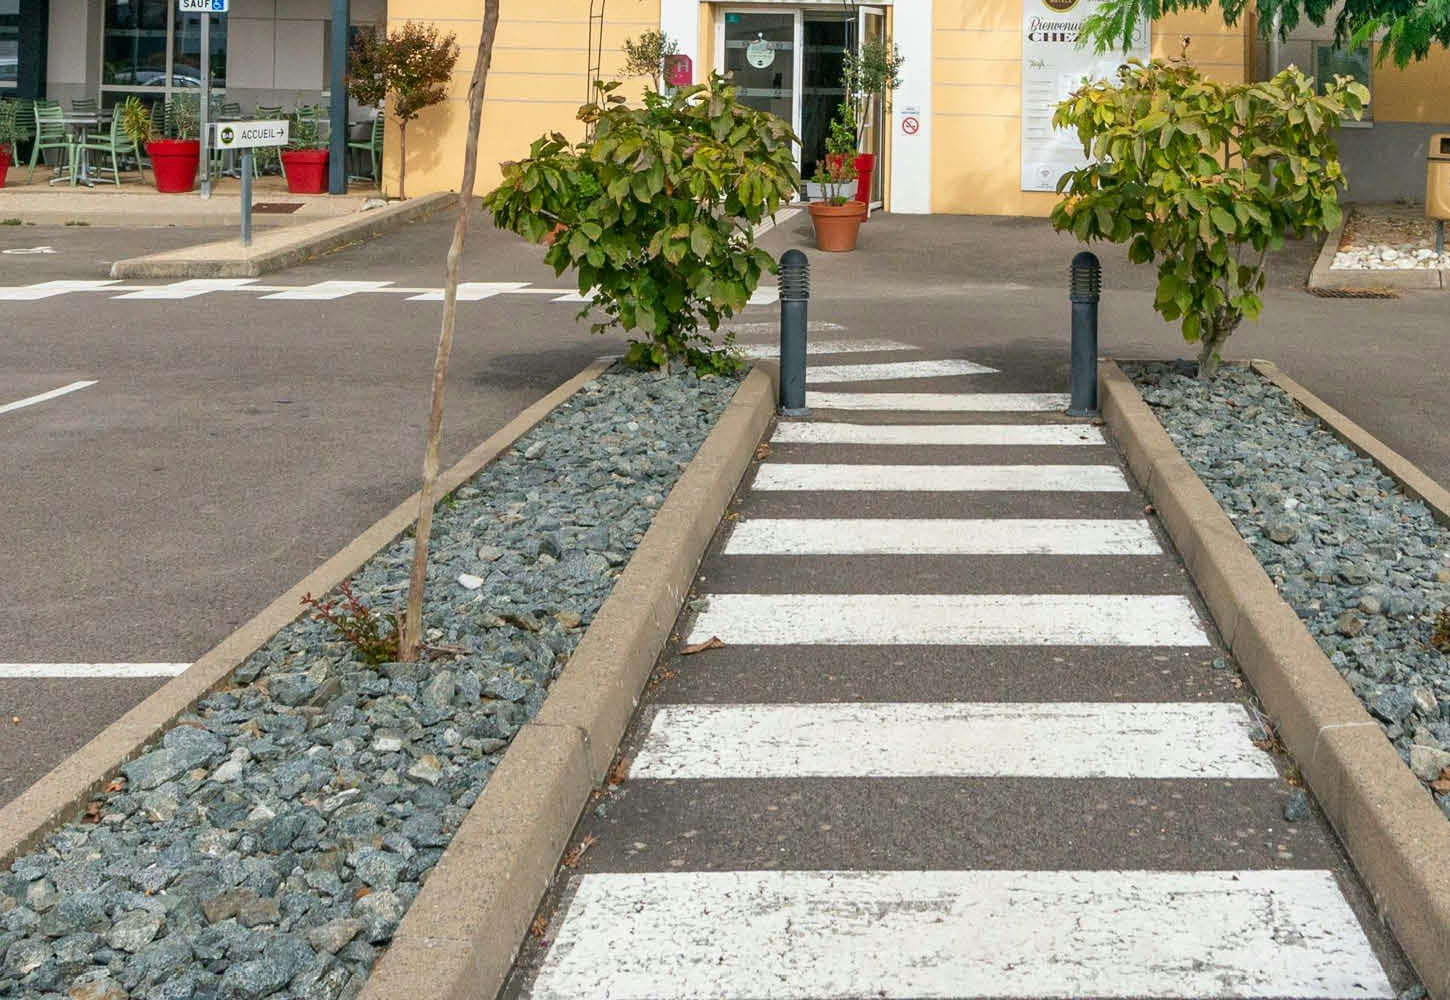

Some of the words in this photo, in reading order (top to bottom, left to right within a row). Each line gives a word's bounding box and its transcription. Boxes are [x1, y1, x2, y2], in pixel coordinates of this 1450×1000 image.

[183, 0, 210, 8] SAUF
[1030, 16, 1081, 32] Bienvenu
[241, 128, 275, 140] ACCUEIL
